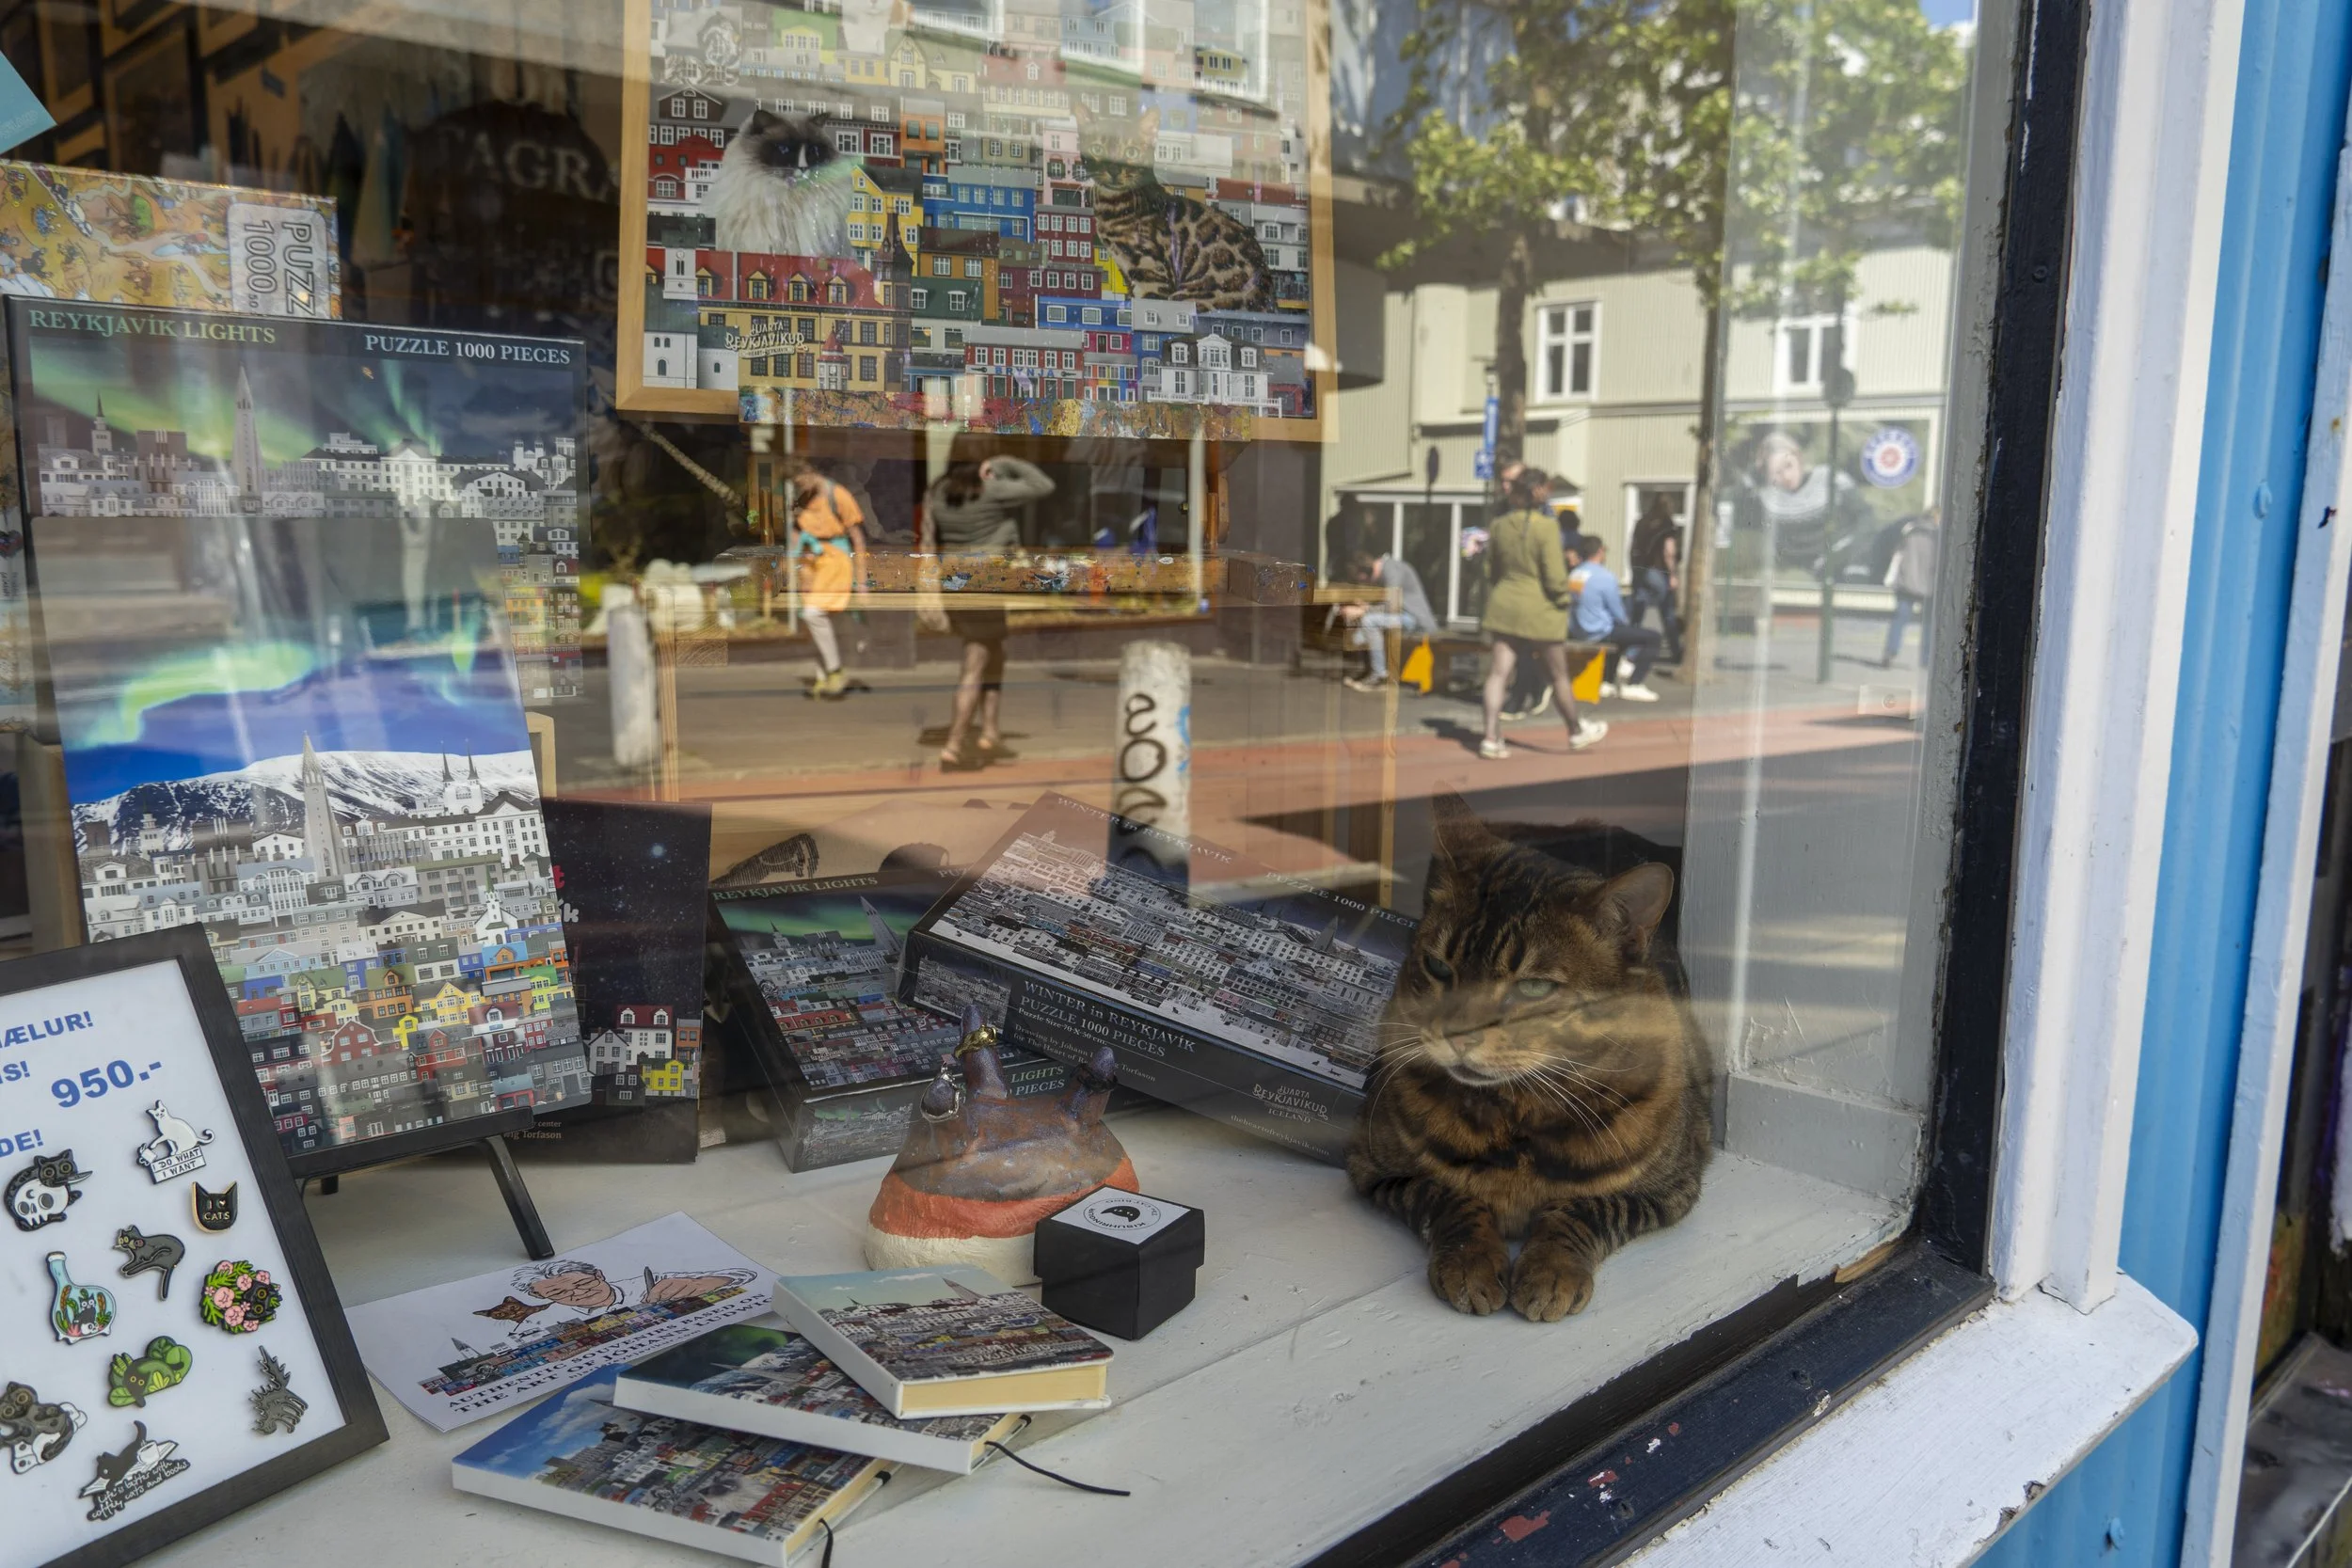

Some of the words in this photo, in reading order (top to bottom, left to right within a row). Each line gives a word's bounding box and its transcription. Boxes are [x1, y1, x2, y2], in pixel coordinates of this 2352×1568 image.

[28, 309, 178, 338] REYKJAVÍK
[183, 321, 276, 343] LIGHTS
[364, 334, 450, 356] PUZZLE
[455, 341, 496, 359] 1000
[501, 345, 570, 365] PIECES
[1057, 797, 1120, 825] WINTER
[1123, 820, 1138, 833] in
[713, 882, 811, 901] REYKJAVÍK
[813, 876, 879, 891] LIGHTS
[1264, 871, 1329, 899] PUZZLE
[1333, 895, 1365, 911] 1000
[1018, 1007, 1044, 1022] Puzzle
[1045, 1017, 1061, 1028] Size
[1020, 995, 1077, 1025] PUZZLE
[1081, 1018, 1110, 1037] 1000
[1113, 1031, 1166, 1058] PIECES
[1024, 980, 1086, 1013] WINTER
[1090, 1005, 1104, 1020] in
[1108, 1011, 1197, 1053] REYKJAVÍK
[0, 1011, 94, 1049] ÆLUR!
[1015, 1023, 1048, 1043] Drawing
[1049, 1037, 1058, 1047] by
[1013, 1032, 1025, 1042] for
[1027, 1037, 1041, 1048] The
[1043, 1043, 1066, 1057] Heart
[0, 1061, 30, 1082] S!
[1011, 1065, 1064, 1083] LIGHTS
[1119, 1062, 1156, 1083] Torfason
[51, 1060, 162, 1108] 950.-
[1016, 1079, 1065, 1096] PIECES
[1268, 1108, 1311, 1124] ICELAND
[522, 1130, 562, 1139] Torfason
[158, 1158, 172, 1168] DO
[176, 1148, 200, 1163] WHAT
[169, 1160, 197, 1176] WANT
[203, 1211, 230, 1221] CATS
[450, 1363, 566, 1408] AUTHENTIC
[571, 1323, 677, 1364] SOUVENIRS
[681, 1304, 736, 1324] BASED
[739, 1293, 765, 1304] ON
[454, 1392, 509, 1413] THE
[516, 1373, 559, 1393] ART
[567, 1359, 596, 1373] OF
[147, 1474, 163, 1488] and
